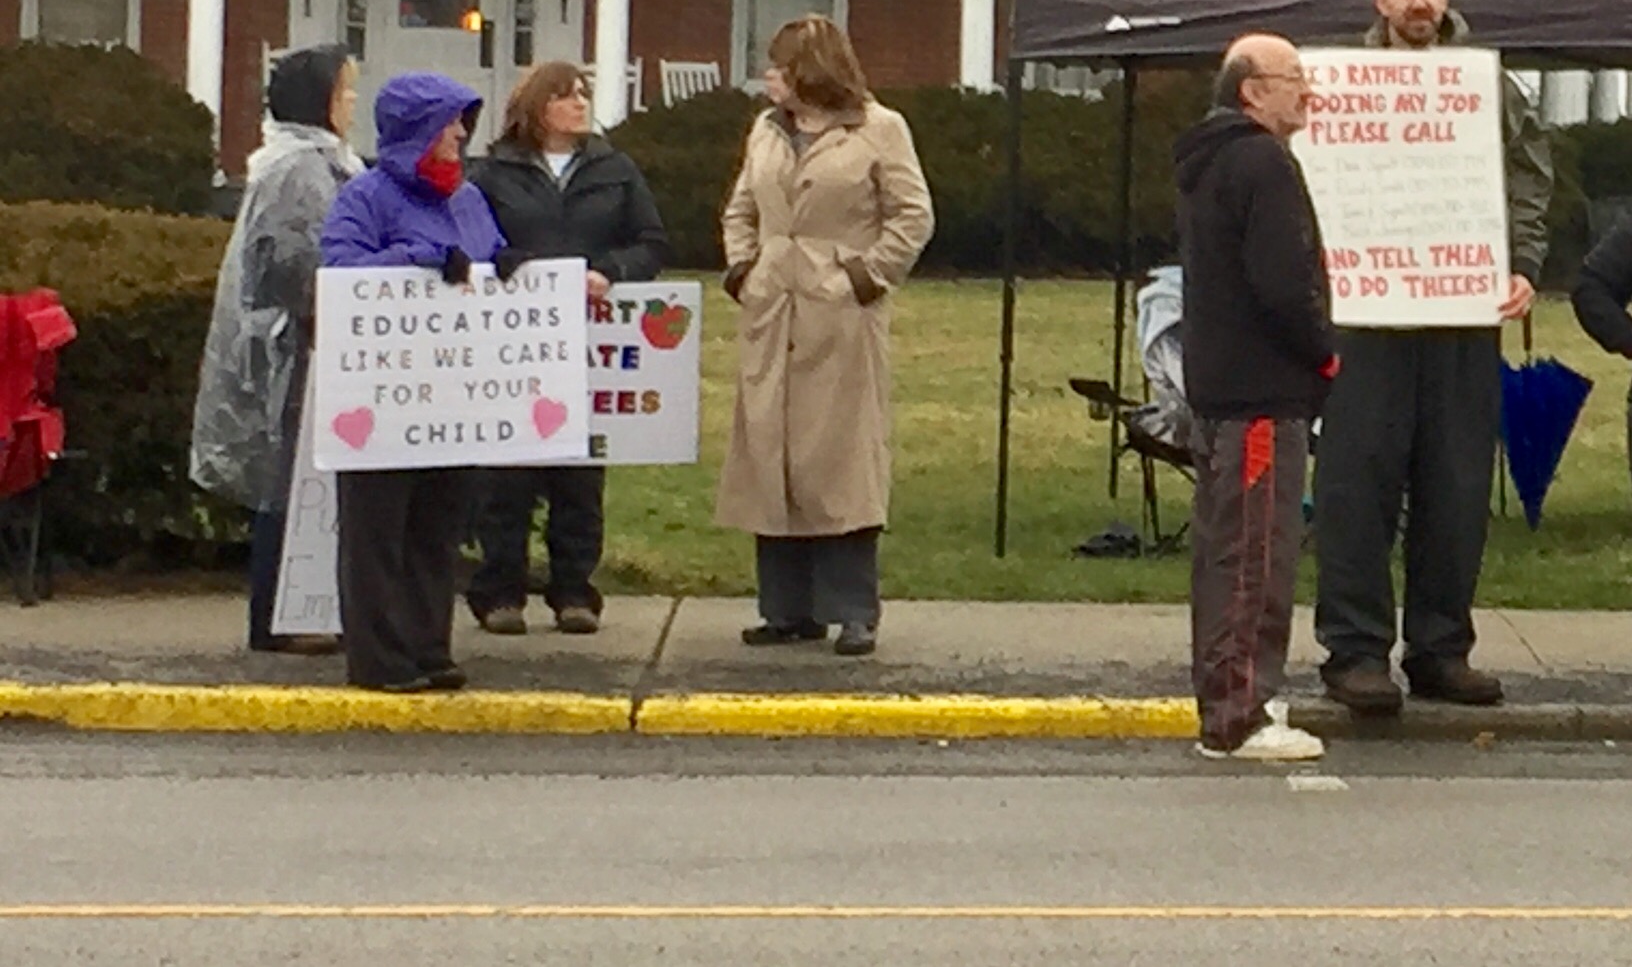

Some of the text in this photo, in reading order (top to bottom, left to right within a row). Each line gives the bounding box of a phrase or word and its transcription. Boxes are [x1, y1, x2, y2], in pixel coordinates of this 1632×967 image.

[1347, 65, 1423, 87] RATHER
[1437, 65, 1462, 86] BE
[1308, 94, 1482, 115] DOING MY JOB
[1310, 121, 1456, 145] PLEASE CALL
[1366, 246, 1420, 269] TELL
[1428, 244, 1495, 268] THEM
[352, 271, 560, 302] CARE ABOUT
[1327, 271, 1499, 298] O DO THEIRS!
[351, 306, 562, 336] EDUCATORS
[588, 298, 638, 324] RT
[340, 341, 570, 373] LIKE WE CARE
[373, 377, 543, 405] FOR YOUR
[588, 389, 661, 415] EES
[404, 420, 516, 446] CHILD
